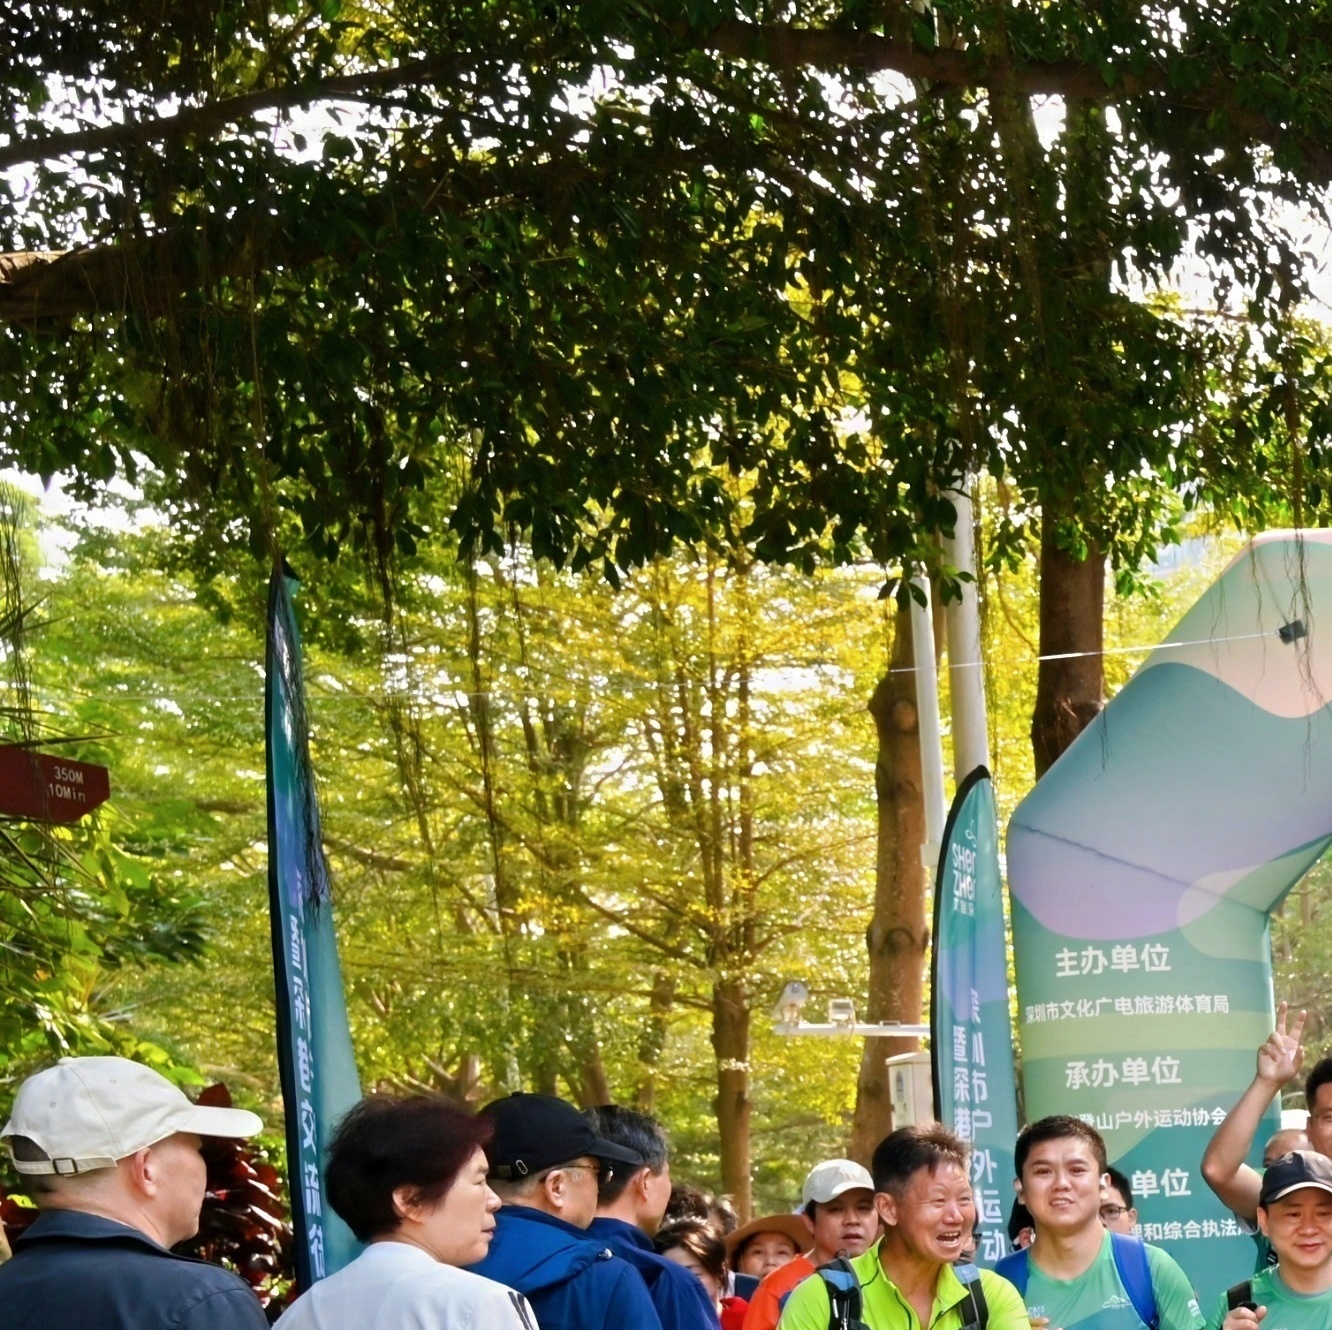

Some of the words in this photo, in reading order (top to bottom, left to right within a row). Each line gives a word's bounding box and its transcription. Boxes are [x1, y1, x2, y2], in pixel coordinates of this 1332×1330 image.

[54, 766, 84, 785] 350M
[953, 869, 977, 902] ZHe
[1056, 943, 1172, 977] 主办单位
[1025, 994, 1230, 1024] 深圳市文化广电旅游体育局
[1065, 1055, 1182, 1090] 承办单位
[1069, 1107, 1228, 1130] 登山户外运动协会
[1131, 1168, 1192, 1198] 单位
